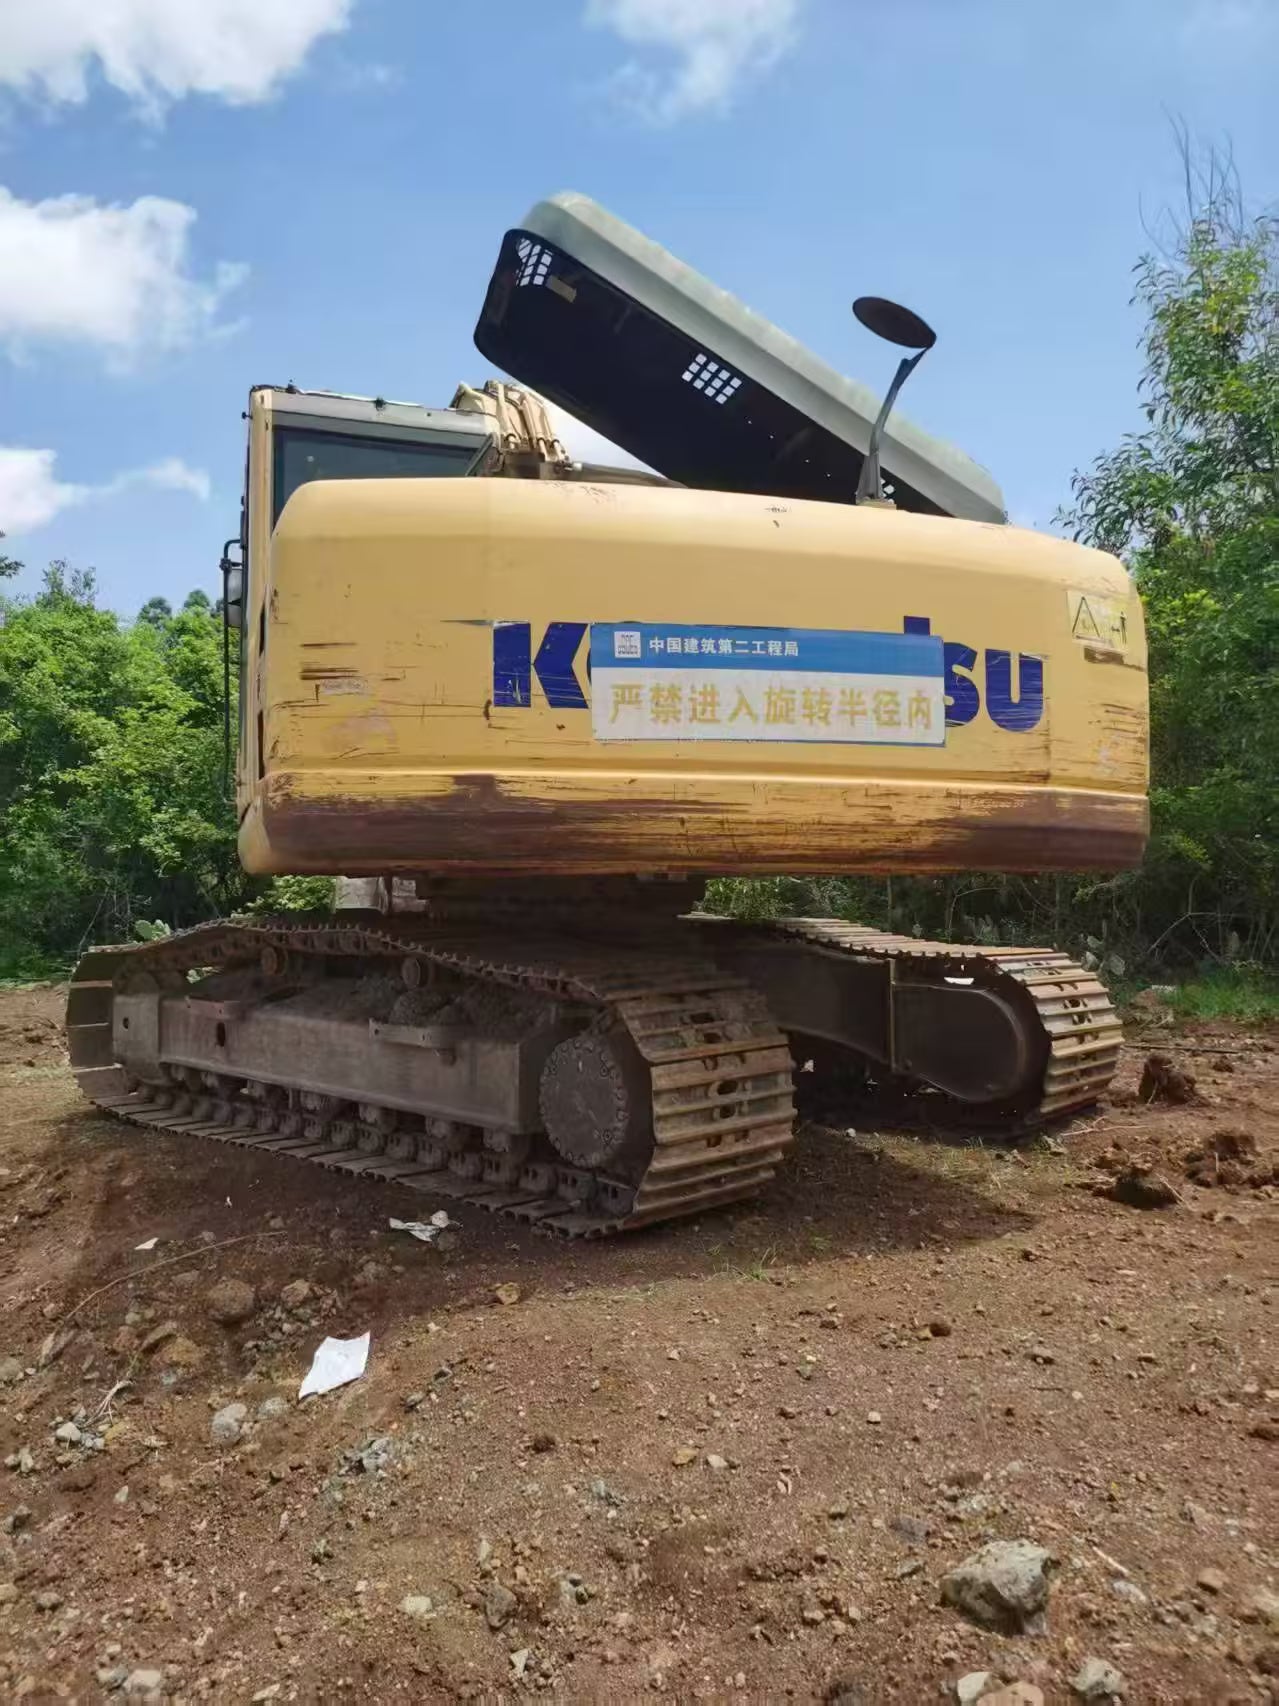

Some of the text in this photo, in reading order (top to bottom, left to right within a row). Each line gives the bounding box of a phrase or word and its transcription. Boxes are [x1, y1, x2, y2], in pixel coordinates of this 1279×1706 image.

[649, 637, 799, 657] 中国建筑第二工程局
[608, 682, 932, 730] 严禁进入旋转半径内
